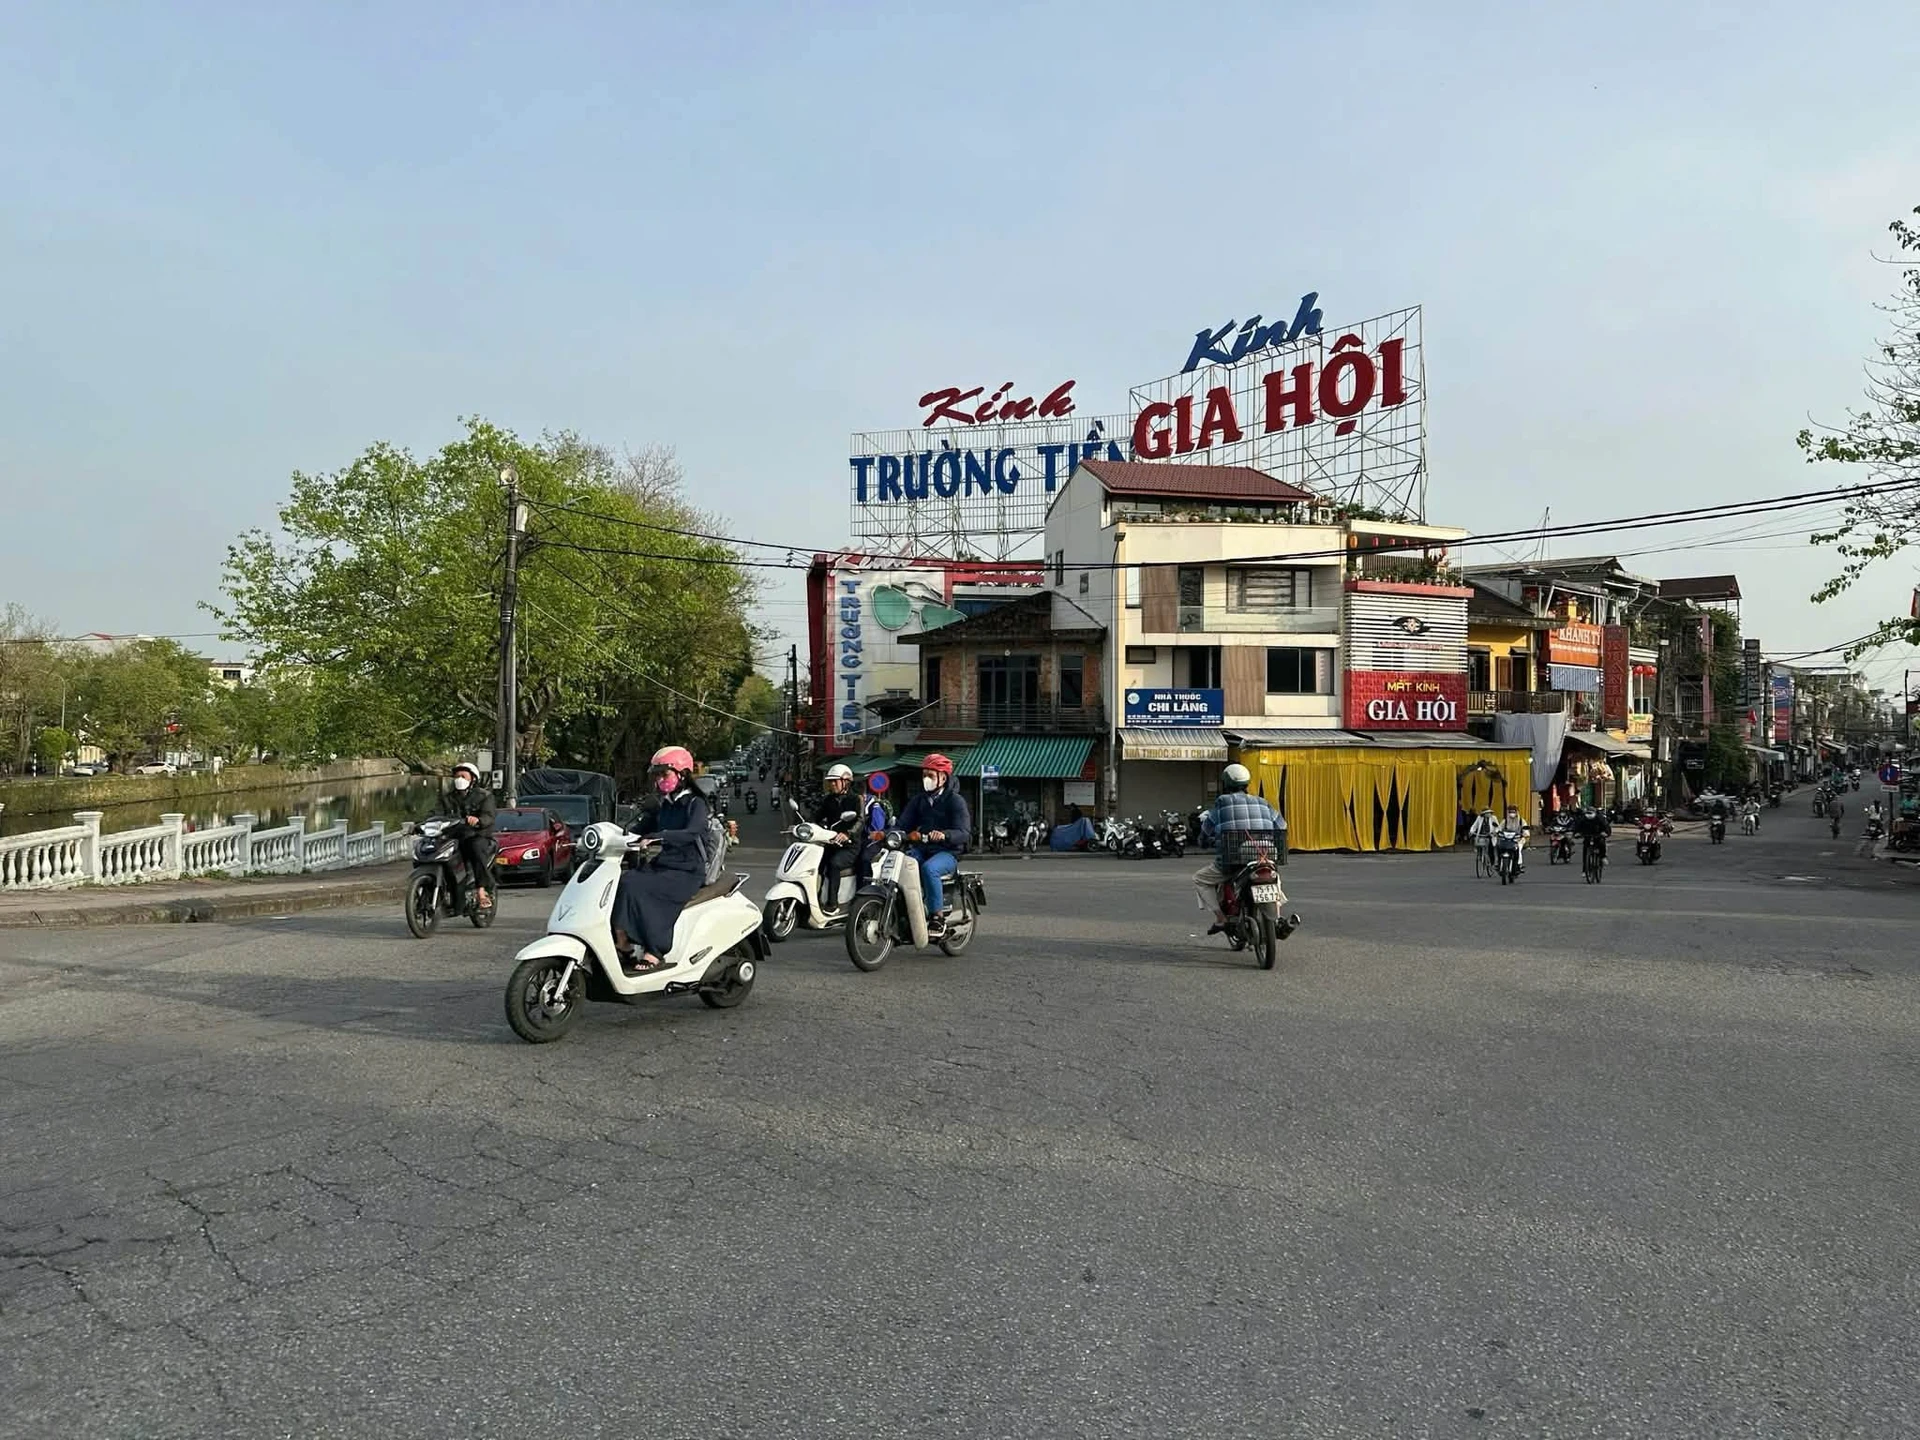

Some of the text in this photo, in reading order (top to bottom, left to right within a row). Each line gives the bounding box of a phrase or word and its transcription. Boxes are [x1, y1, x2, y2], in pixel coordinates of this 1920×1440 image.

[1181, 291, 1324, 374] Kính
[919, 380, 1076, 427] Kính
[1133, 333, 1408, 460] GIA HỘI
[849, 439, 1021, 502] TRƯỜNG
[1148, 702, 1169, 712] CHI
[1368, 693, 1457, 727] GIA HỘI
